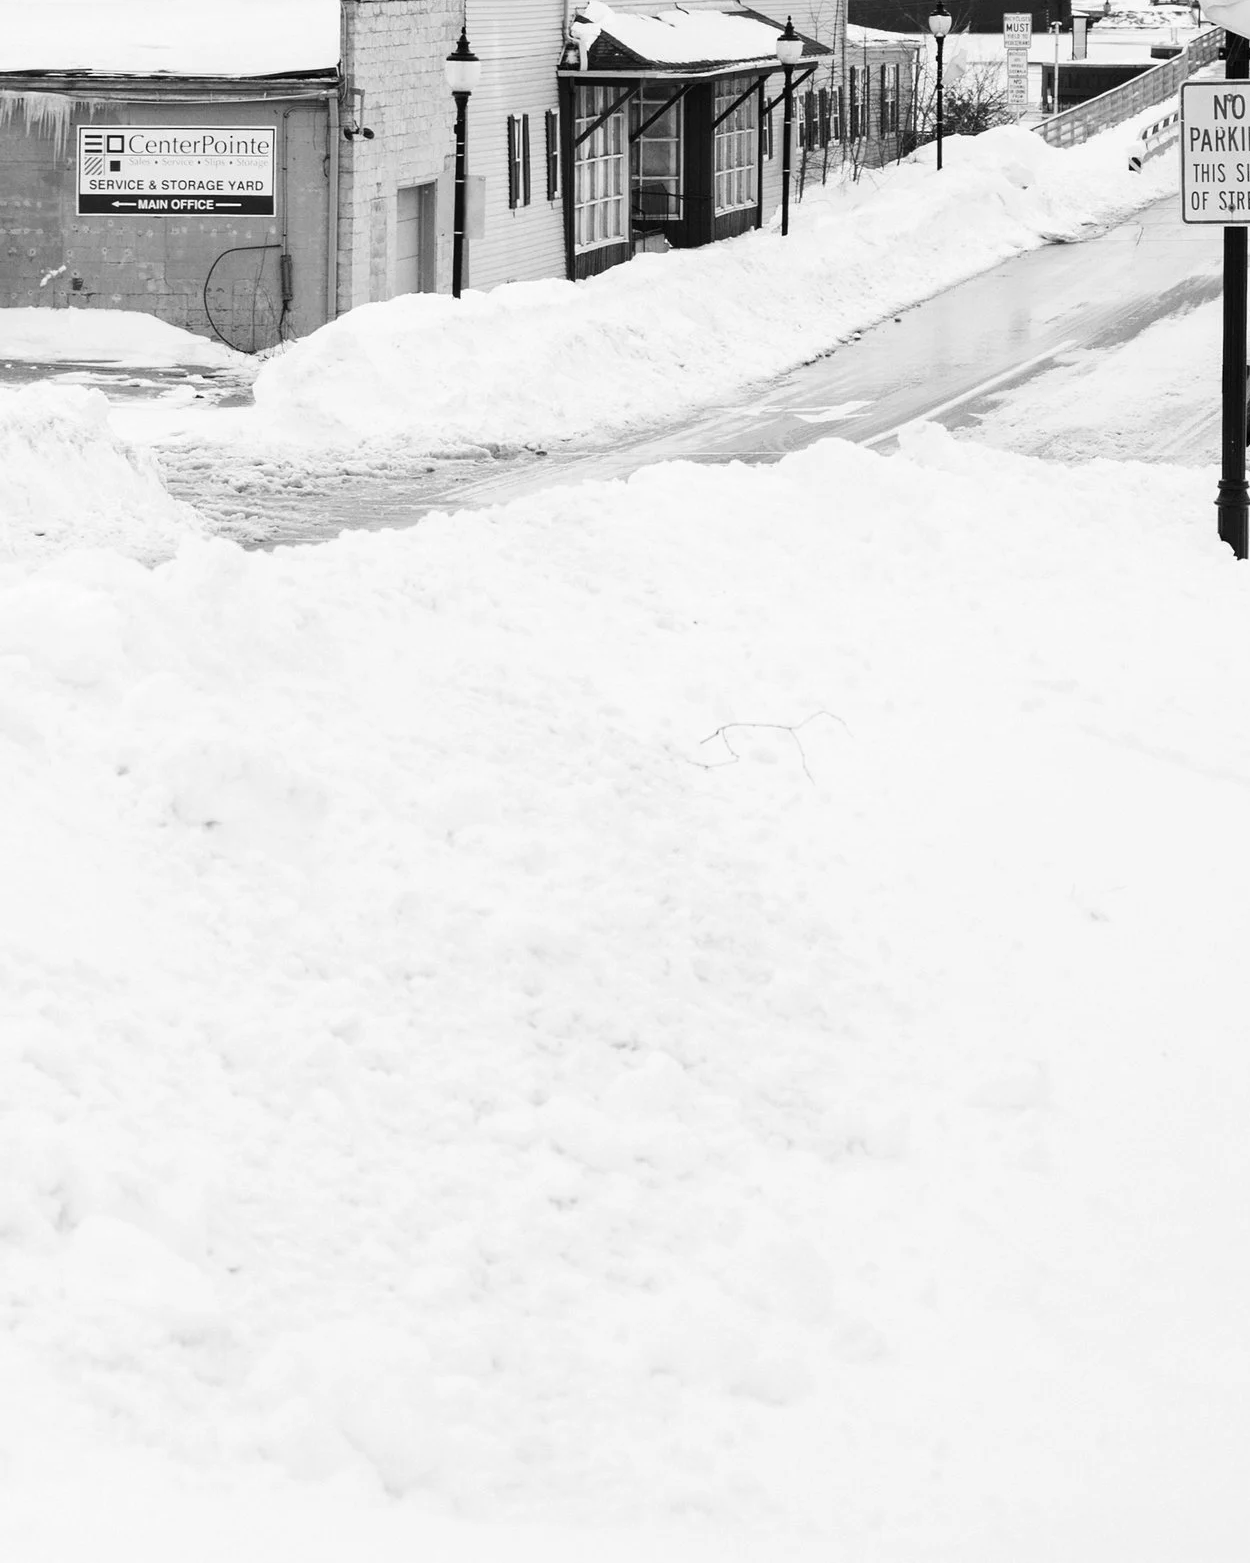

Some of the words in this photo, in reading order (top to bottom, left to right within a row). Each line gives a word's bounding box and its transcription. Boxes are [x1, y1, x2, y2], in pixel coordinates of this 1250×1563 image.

[1006, 23, 1029, 32] MUST
[1213, 94, 1246, 120] NO
[128, 134, 270, 155] CenterPointe
[128, 158, 151, 166] Sales
[162, 158, 194, 167] Service
[204, 158, 226, 169] Slips
[236, 158, 269, 169] Storage
[1193, 163, 1226, 183] THIS
[89, 179, 144, 190] SERVICE
[149, 180, 157, 190] &
[161, 180, 224, 191] STORAGE
[228, 180, 264, 191] YARD
[137, 199, 170, 210] MAIN
[171, 199, 214, 210] OFFICE
[1191, 191, 1209, 210] OF
